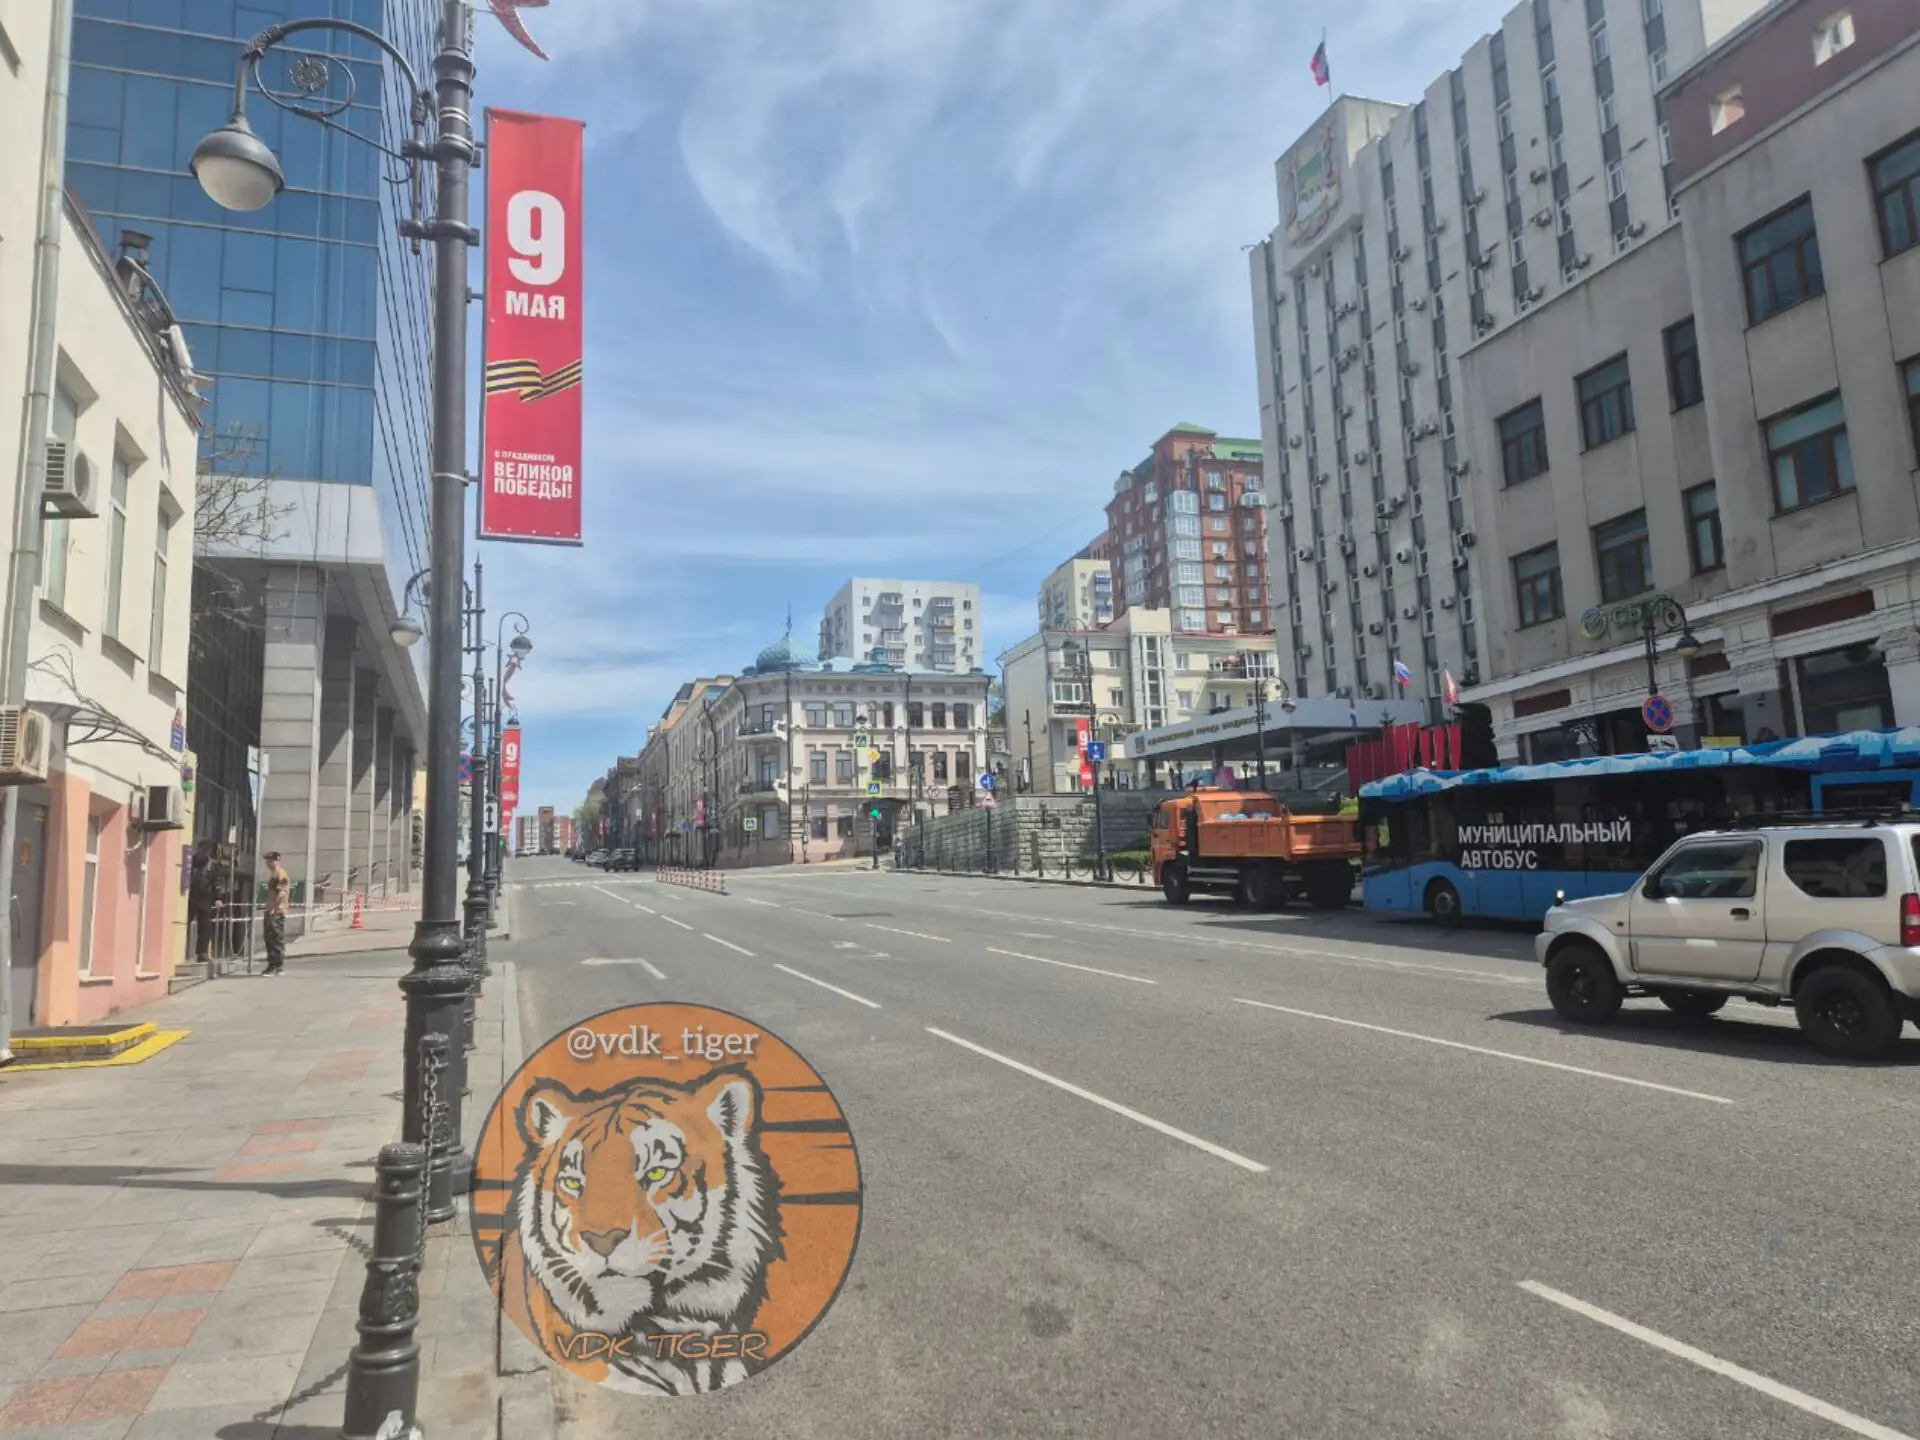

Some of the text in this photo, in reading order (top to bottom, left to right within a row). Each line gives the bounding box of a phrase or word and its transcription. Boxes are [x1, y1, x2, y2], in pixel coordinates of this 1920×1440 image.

[507, 190, 565, 286] 9
[505, 290, 565, 320] МАЯ
[494, 461, 573, 482] ВЕЛИКОЙ
[494, 477, 573, 500] ПОБЕДЫ!
[1458, 816, 1632, 848] МУНИЦИПАЛЬНЫЙ
[1461, 850, 1538, 869] АВТОБУС
